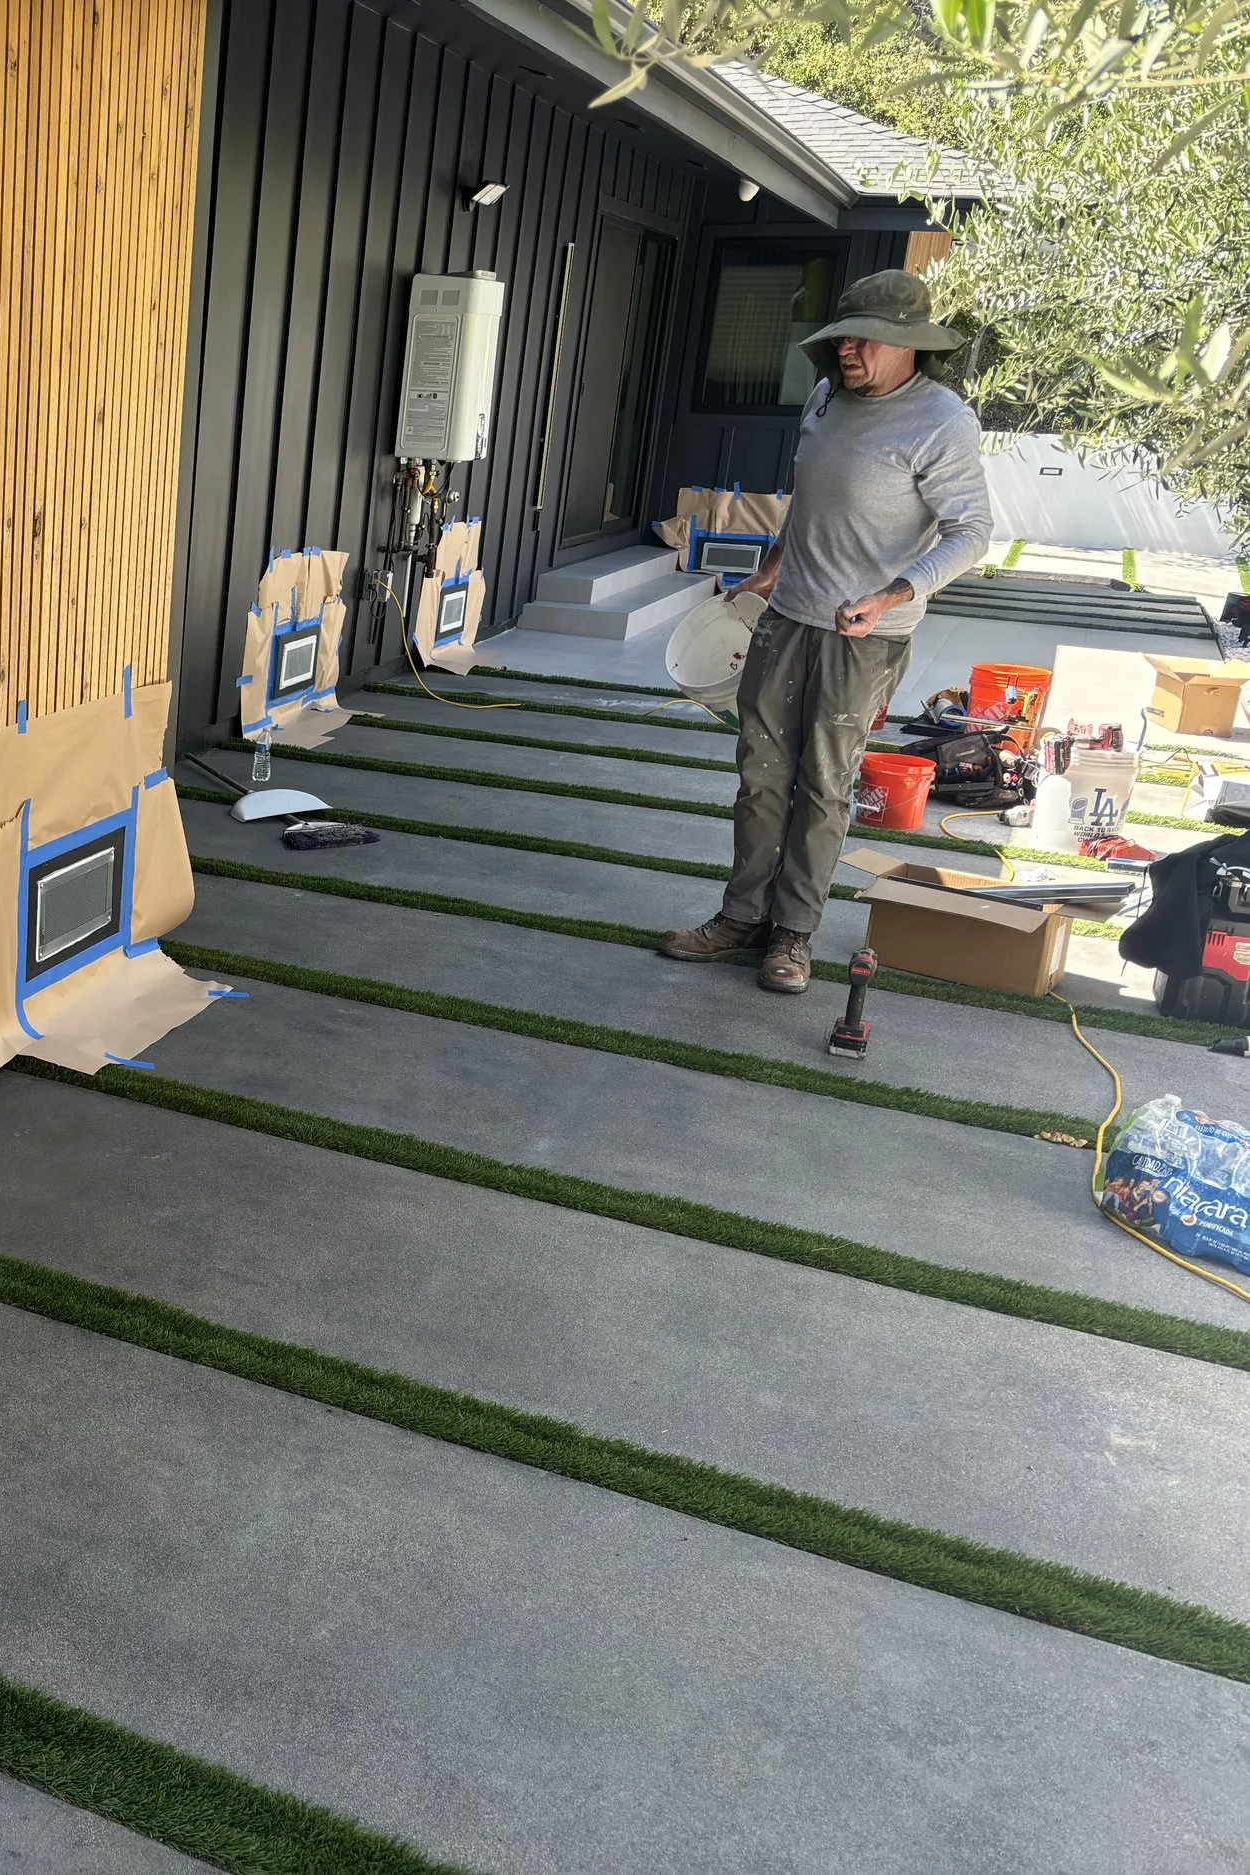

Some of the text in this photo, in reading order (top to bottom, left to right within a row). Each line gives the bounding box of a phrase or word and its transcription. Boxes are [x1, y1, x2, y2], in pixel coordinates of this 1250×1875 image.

[1089, 787, 1119, 827] LA
[1073, 825, 1094, 833] BACK
[1162, 1176, 1249, 1229] niagara
[1199, 1220, 1234, 1238] PURIFICADA
